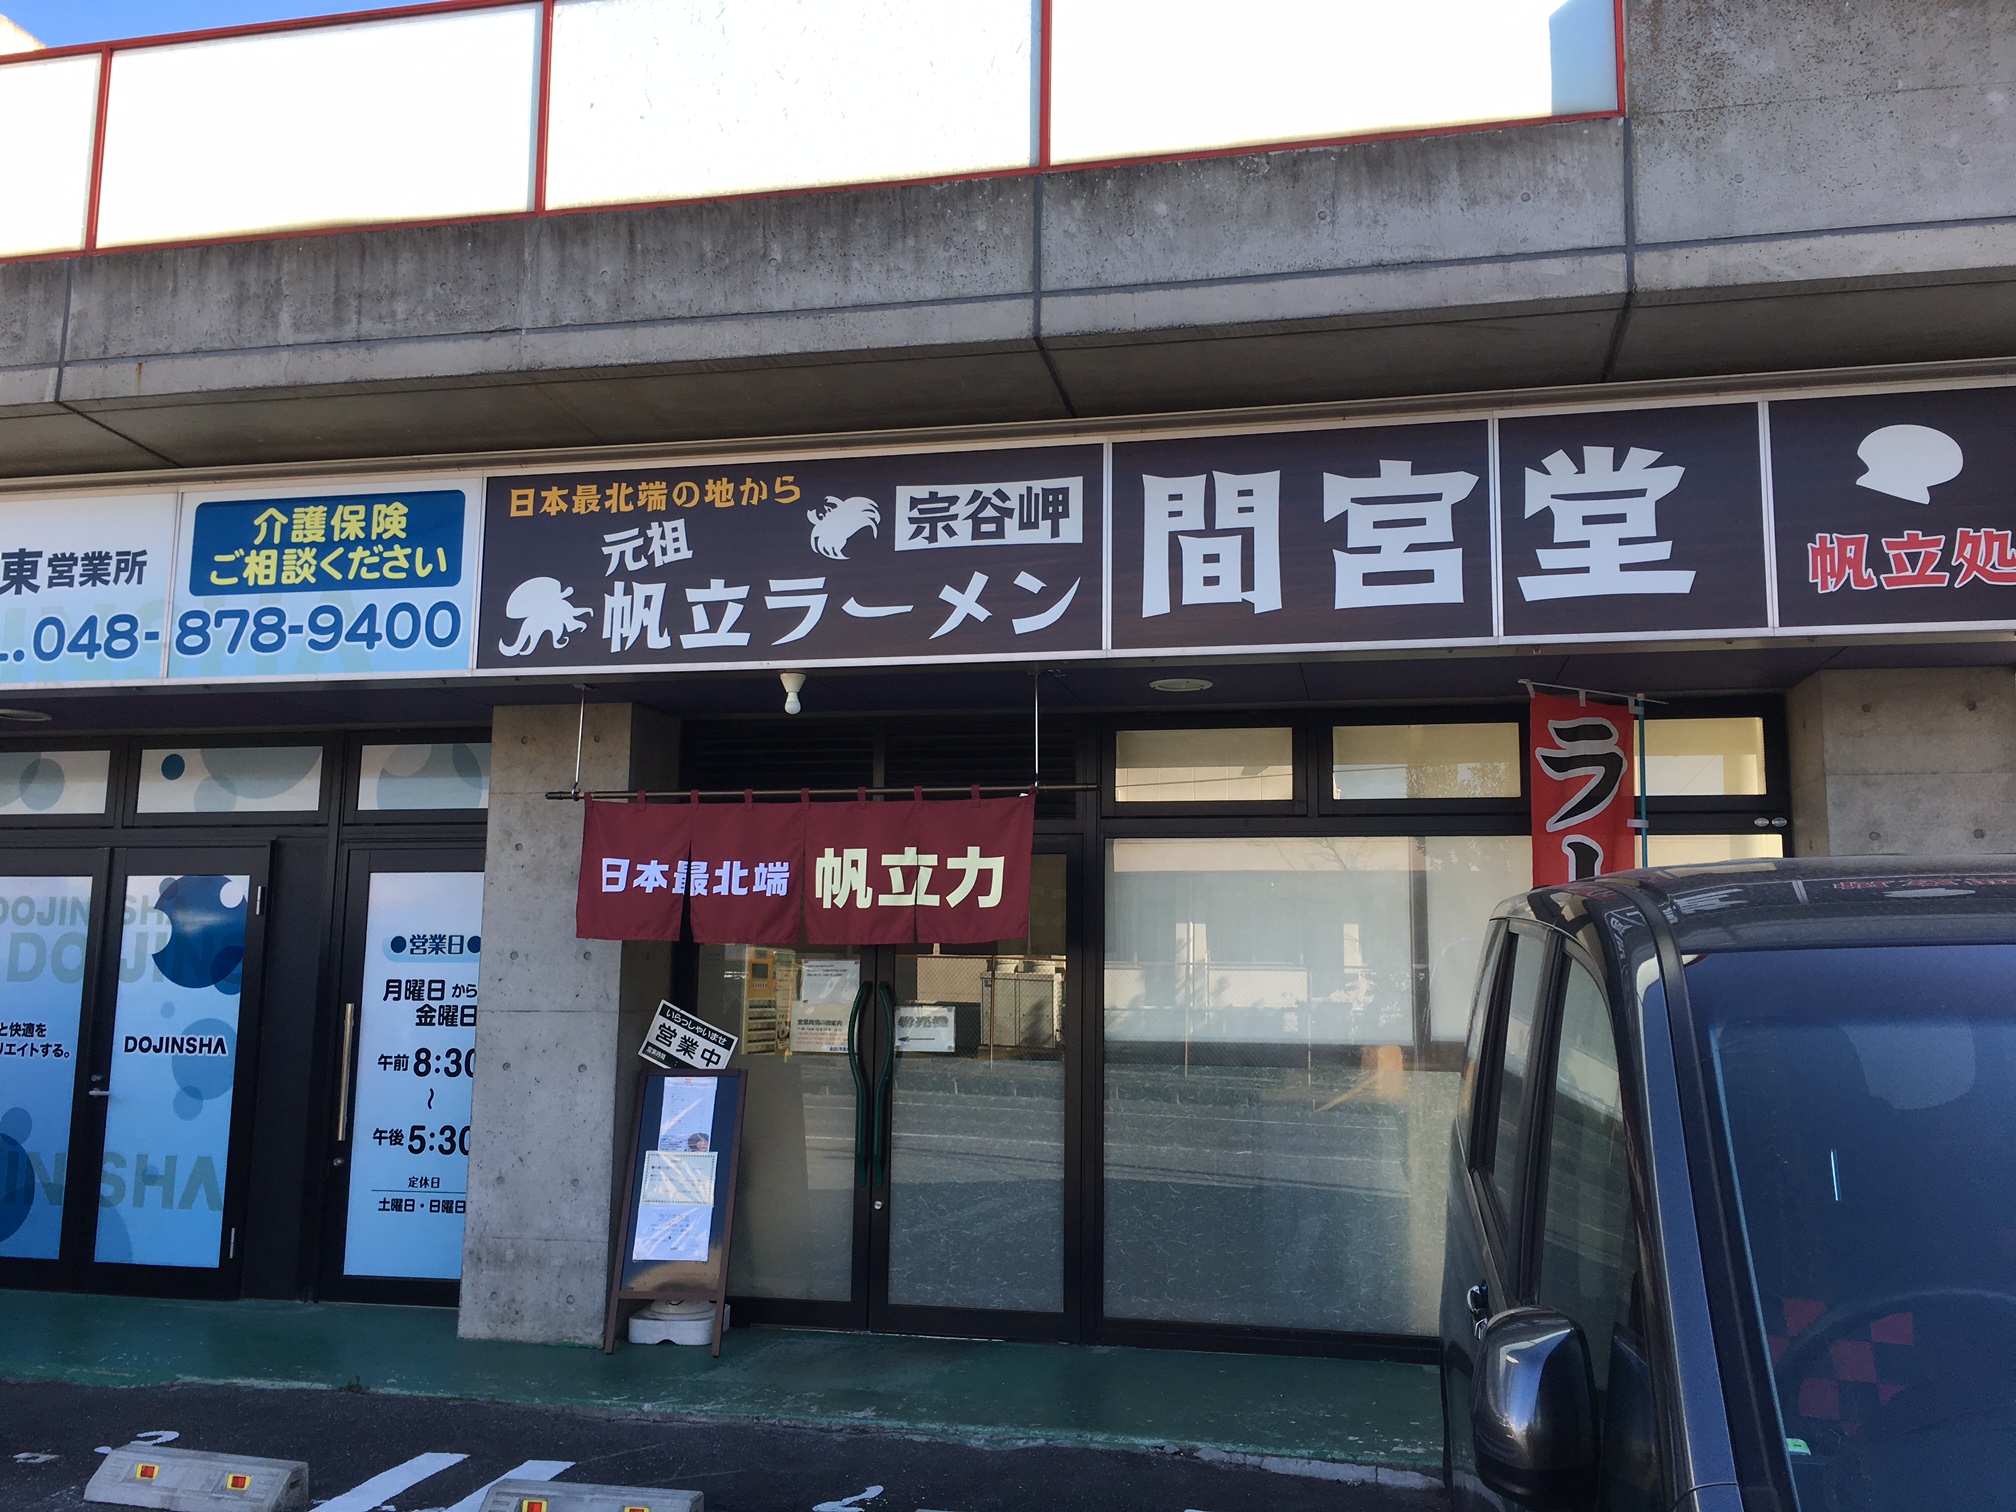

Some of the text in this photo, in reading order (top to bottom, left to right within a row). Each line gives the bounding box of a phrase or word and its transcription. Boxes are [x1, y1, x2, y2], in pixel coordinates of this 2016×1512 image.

[509, 475, 801, 517] 日本最北端の地から
[907, 486, 1071, 543] 宗谷岬
[253, 502, 409, 545] 介護保険
[1142, 446, 1697, 618] 間宮堂
[209, 544, 447, 587] ご相談ください
[601, 519, 694, 577] 元祖
[1807, 528, 2016, 593] 帆立処
[0, 548, 148, 595] 東営業所
[602, 570, 1081, 653] 帆立ラーメン
[601, 846, 1005, 909] 日本最北端 帆立力
[415, 1003, 477, 1027] 金曜日
[666, 1008, 727, 1046] いらっしゃいませ
[124, 1036, 227, 1055] DOJINSHA
[655, 1022, 721, 1067] 営業中
[408, 1176, 440, 1189] 定休日
